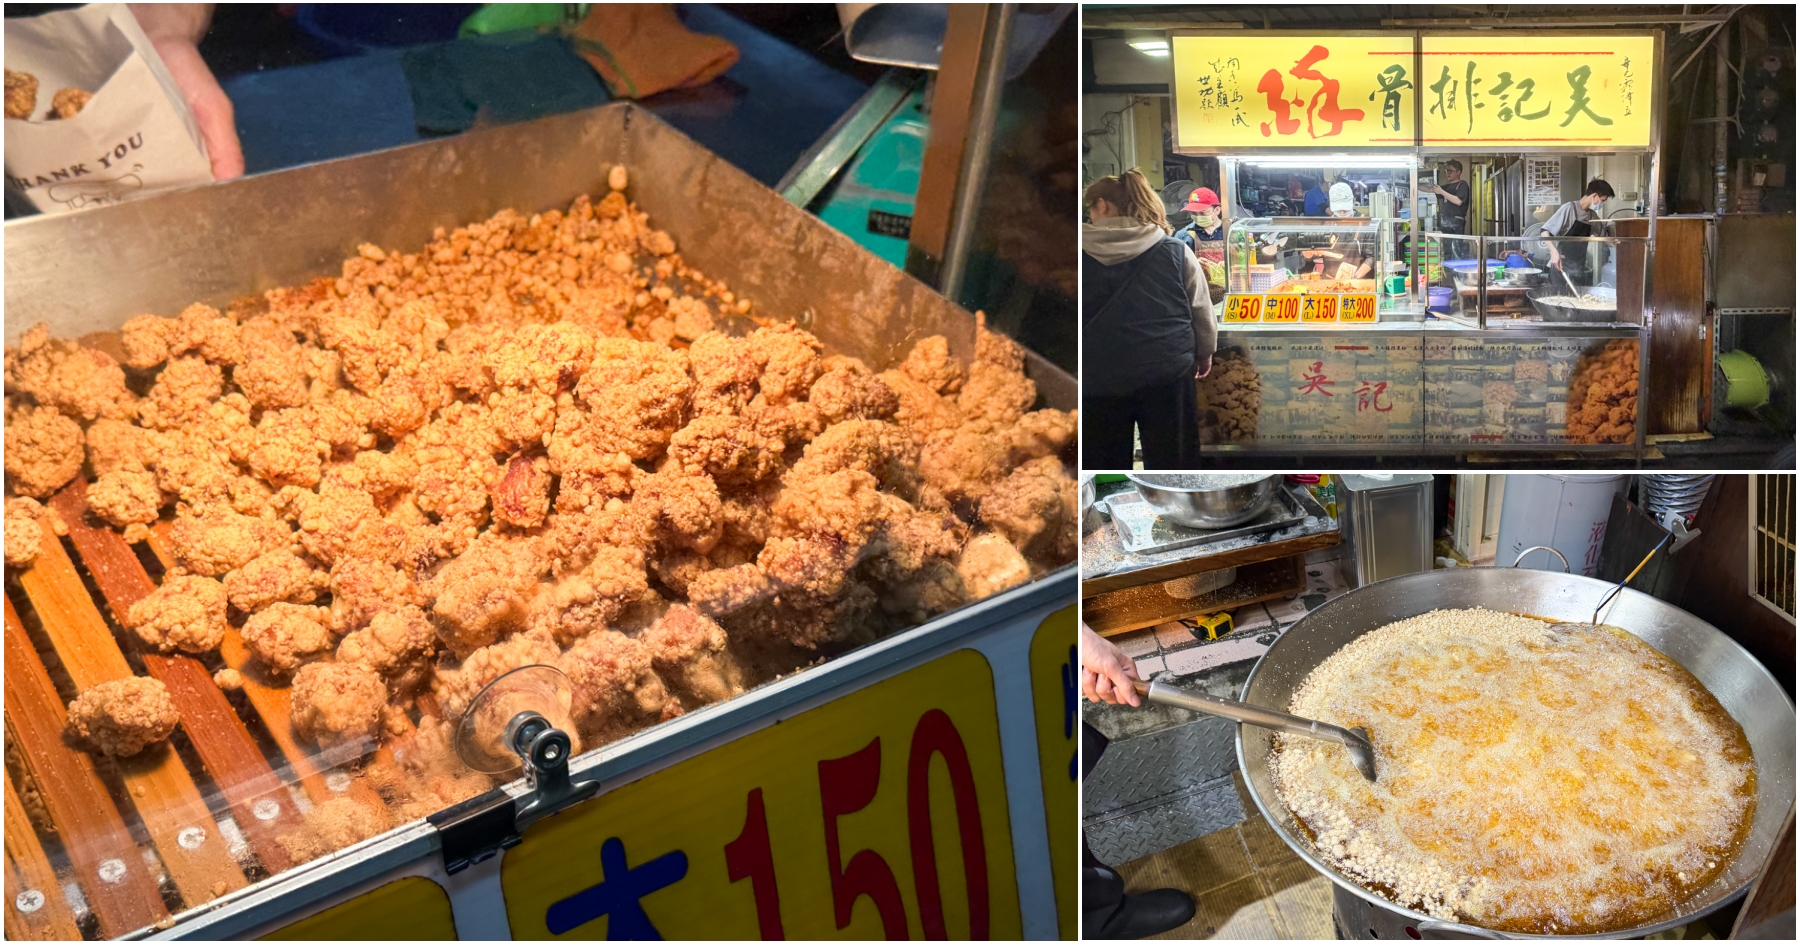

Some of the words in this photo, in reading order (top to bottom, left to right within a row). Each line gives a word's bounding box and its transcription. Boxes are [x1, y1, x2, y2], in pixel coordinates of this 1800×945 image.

[98, 132, 143, 169] YOU
[1227, 312, 1237, 320] (S)
[1229, 297, 1239, 310] 小
[1239, 298, 1260, 319] 50
[1266, 312, 1275, 320] (M)
[1267, 298, 1277, 310] 中
[1277, 298, 1298, 319] 100
[1304, 312, 1314, 320] (L)
[1305, 298, 1315, 310] 大
[1316, 298, 1336, 319] 150
[1342, 312, 1355, 320] (XL)
[1343, 298, 1355, 310] 特大
[1356, 298, 1374, 319] 200
[546, 837, 689, 941] 大
[724, 708, 990, 941] 150
